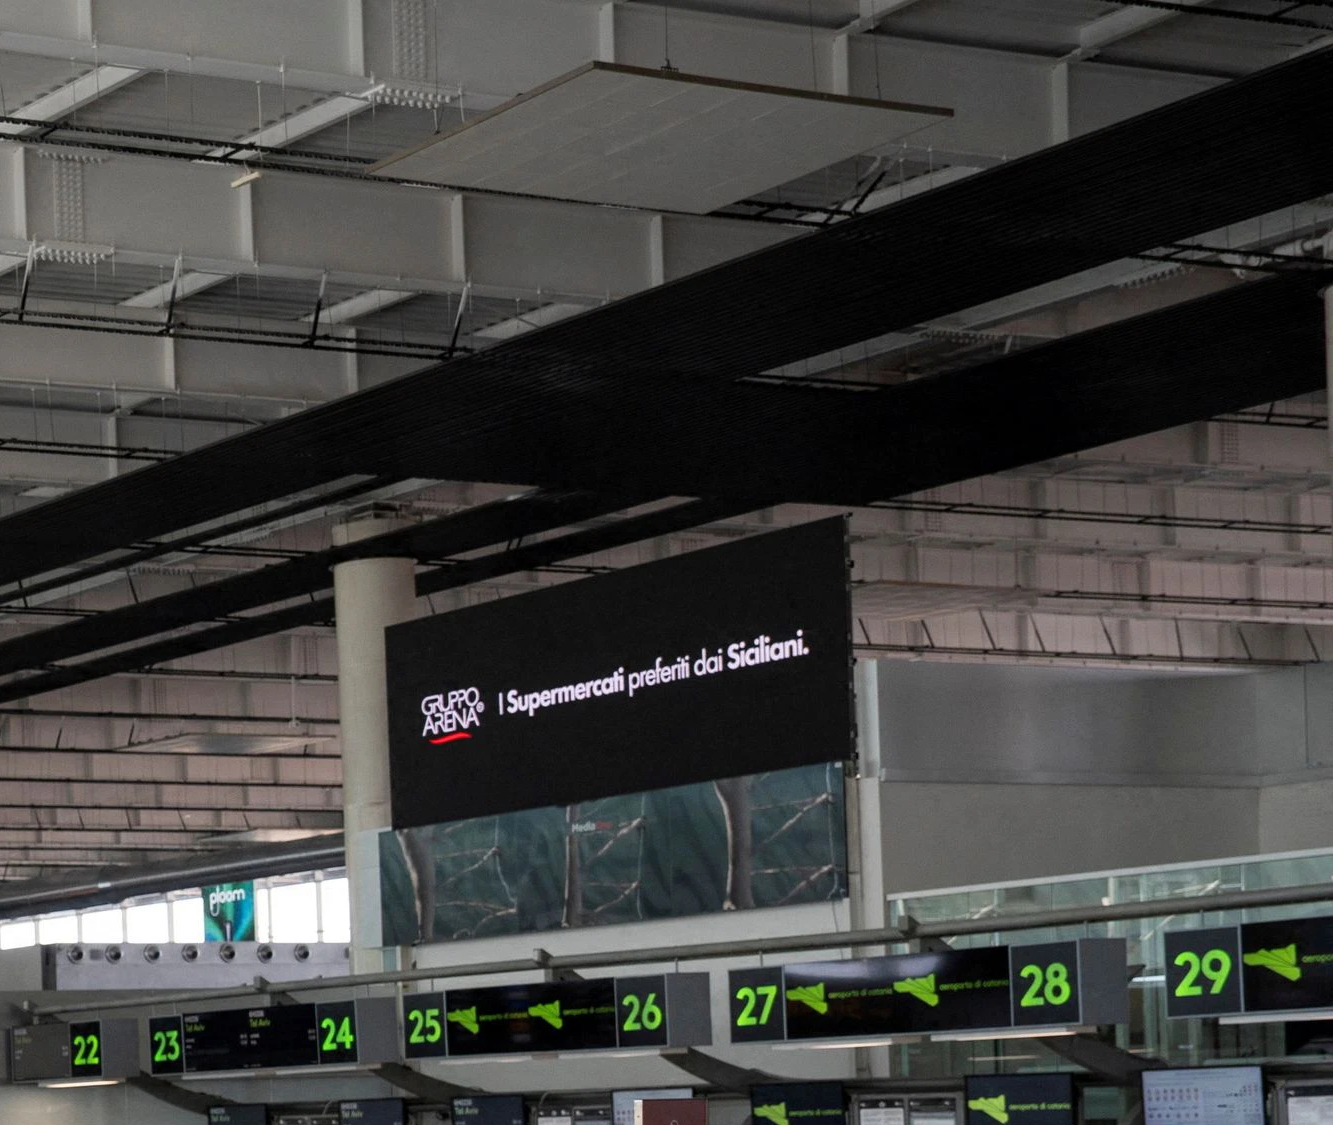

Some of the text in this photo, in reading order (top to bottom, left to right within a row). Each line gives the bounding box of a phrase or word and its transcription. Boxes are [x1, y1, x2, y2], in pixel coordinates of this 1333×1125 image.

[506, 666, 624, 716] Supermercati
[628, 655, 690, 698] preferiti
[693, 648, 723, 677] dai
[727, 629, 810, 670] Siciliani.
[421, 686, 480, 716] GRUPPO
[422, 708, 480, 737] ARENA
[1020, 962, 1071, 1008] 28
[1174, 949, 1232, 997] 29
[622, 993, 662, 1031] 26
[736, 985, 777, 1026] 27
[321, 1017, 354, 1051] 24
[408, 1008, 441, 1043] 25
[74, 1035, 99, 1065] 22
[154, 1030, 180, 1062] 23
